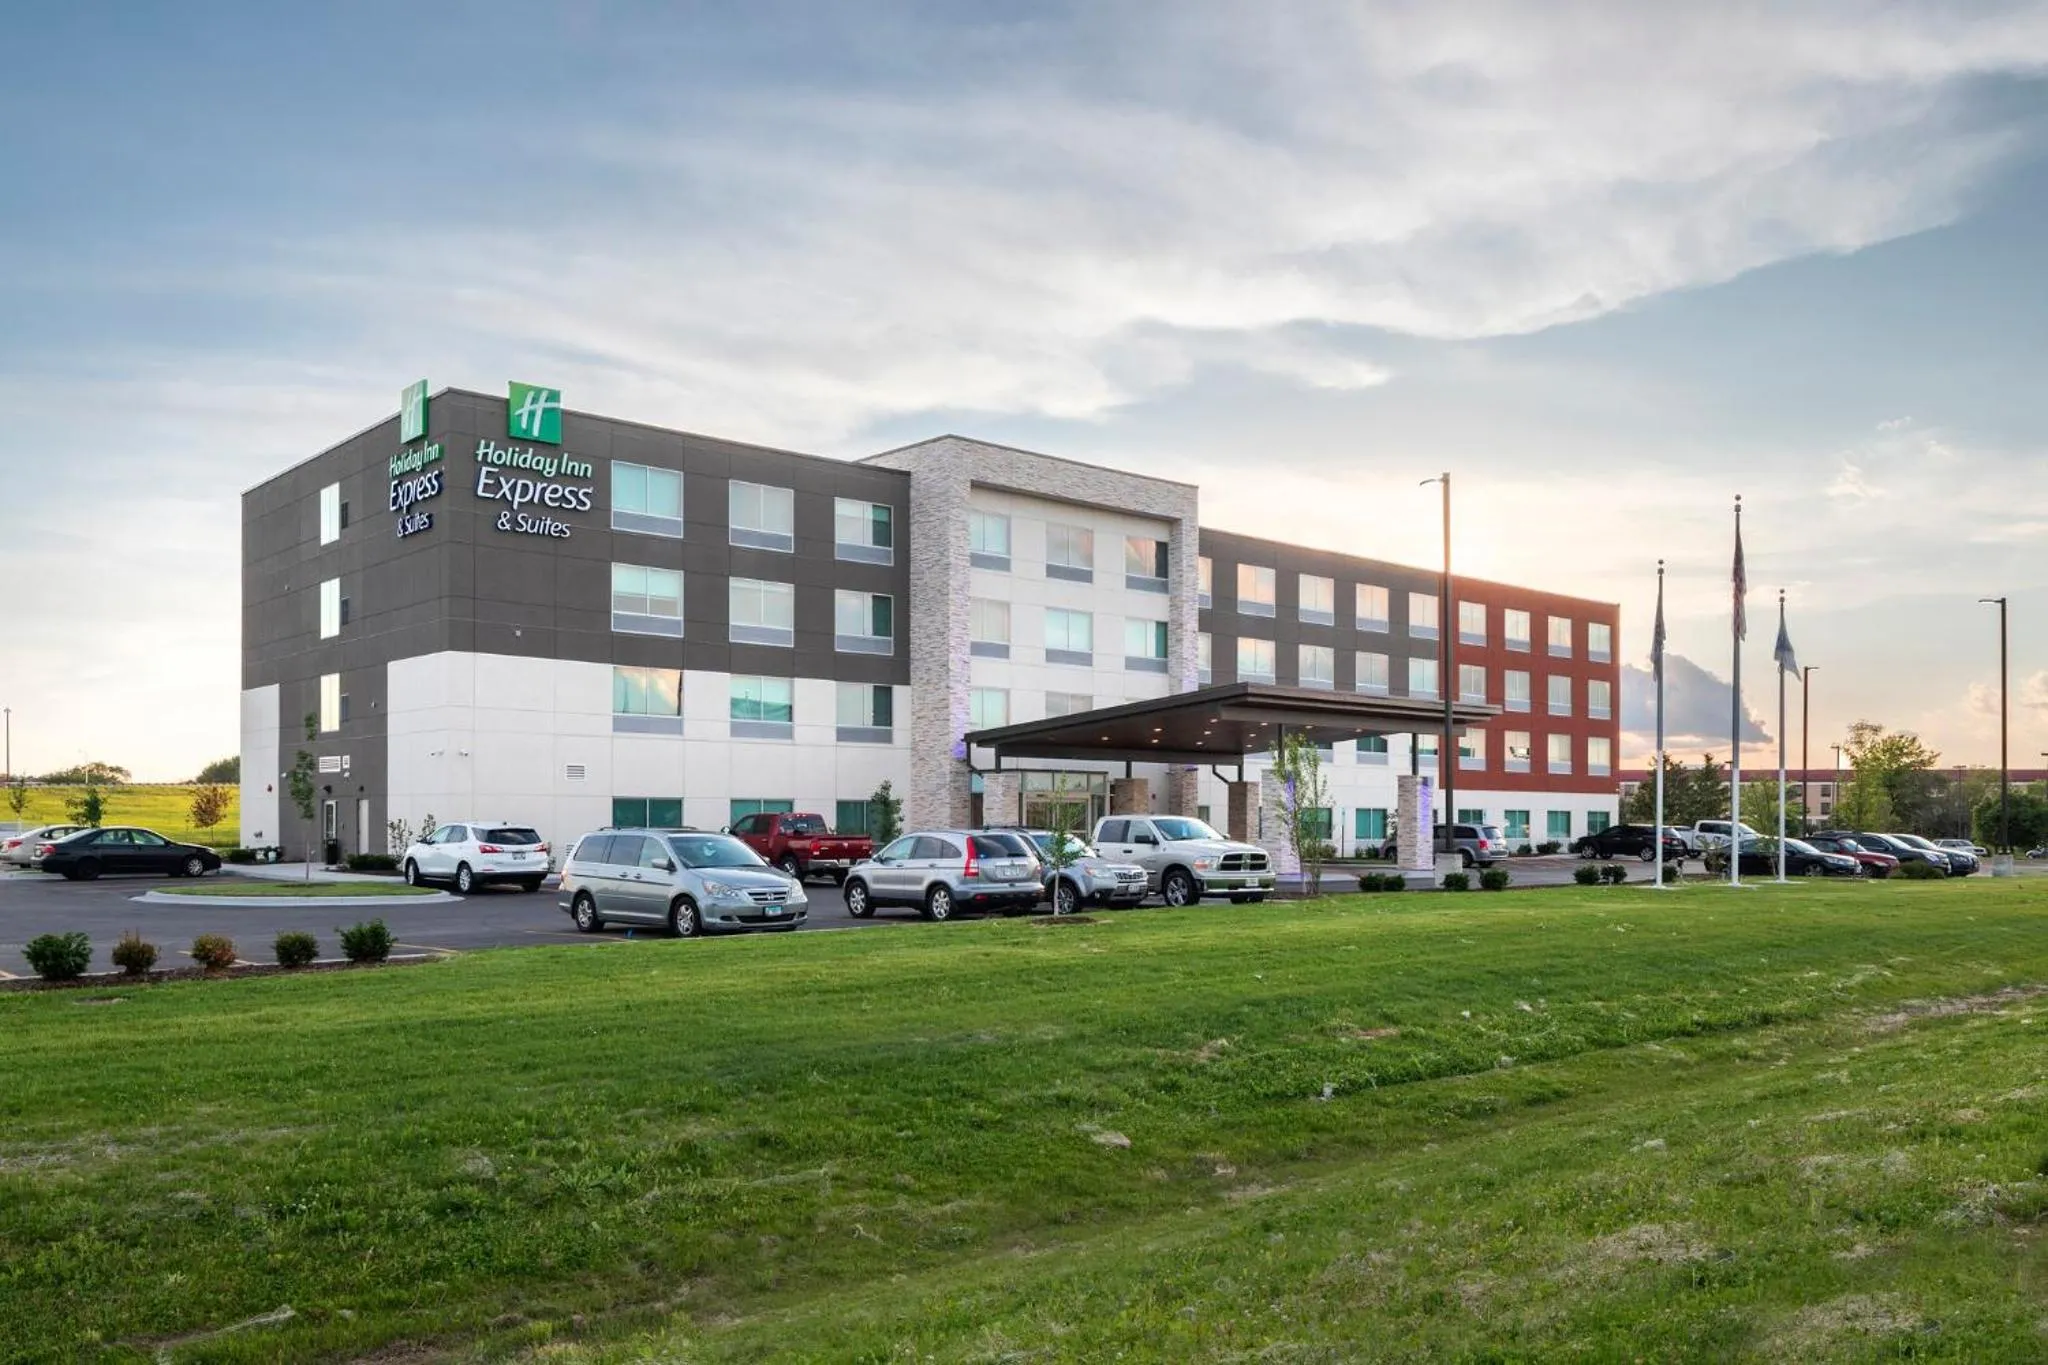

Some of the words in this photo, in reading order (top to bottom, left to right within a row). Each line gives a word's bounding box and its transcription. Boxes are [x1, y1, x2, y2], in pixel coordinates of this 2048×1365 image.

[389, 448, 423, 477] Holiday
[424, 440, 439, 463] Inn
[476, 439, 558, 478] Holiday
[561, 453, 593, 478] Inn
[389, 470, 439, 514] Express
[477, 466, 593, 512] Express
[397, 518, 404, 537] &
[404, 512, 430, 535] Suites
[497, 511, 511, 531] &
[516, 512, 571, 538] Suites
